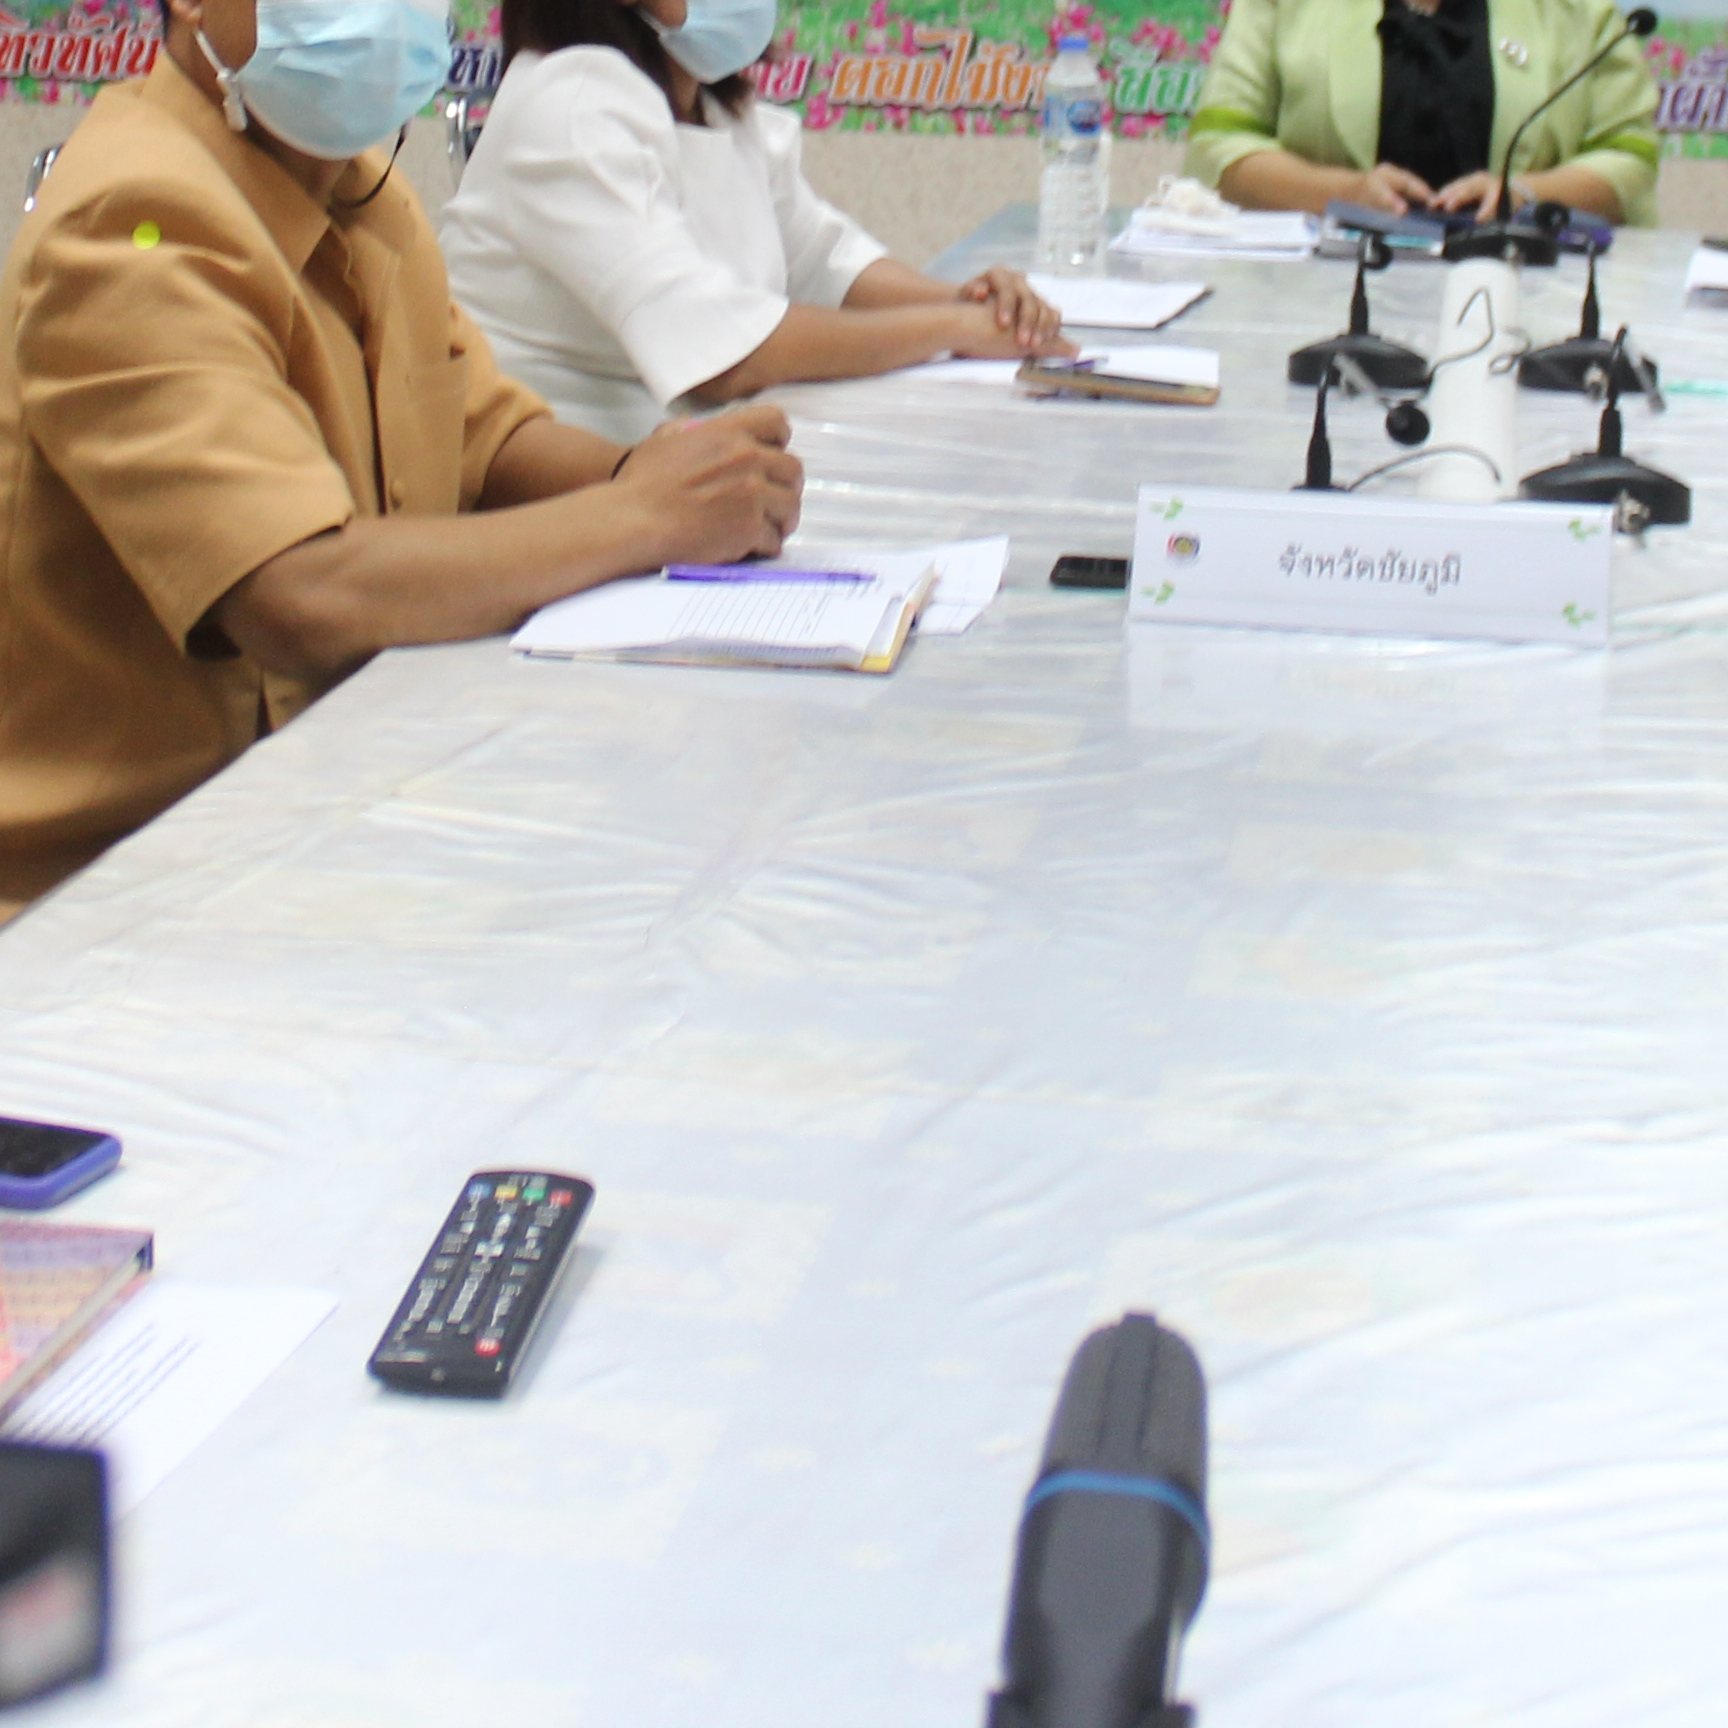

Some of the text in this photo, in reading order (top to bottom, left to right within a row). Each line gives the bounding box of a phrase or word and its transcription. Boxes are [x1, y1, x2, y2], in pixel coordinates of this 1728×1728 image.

[1278, 542, 1462, 596] จังหวัดชัยภูมิ
